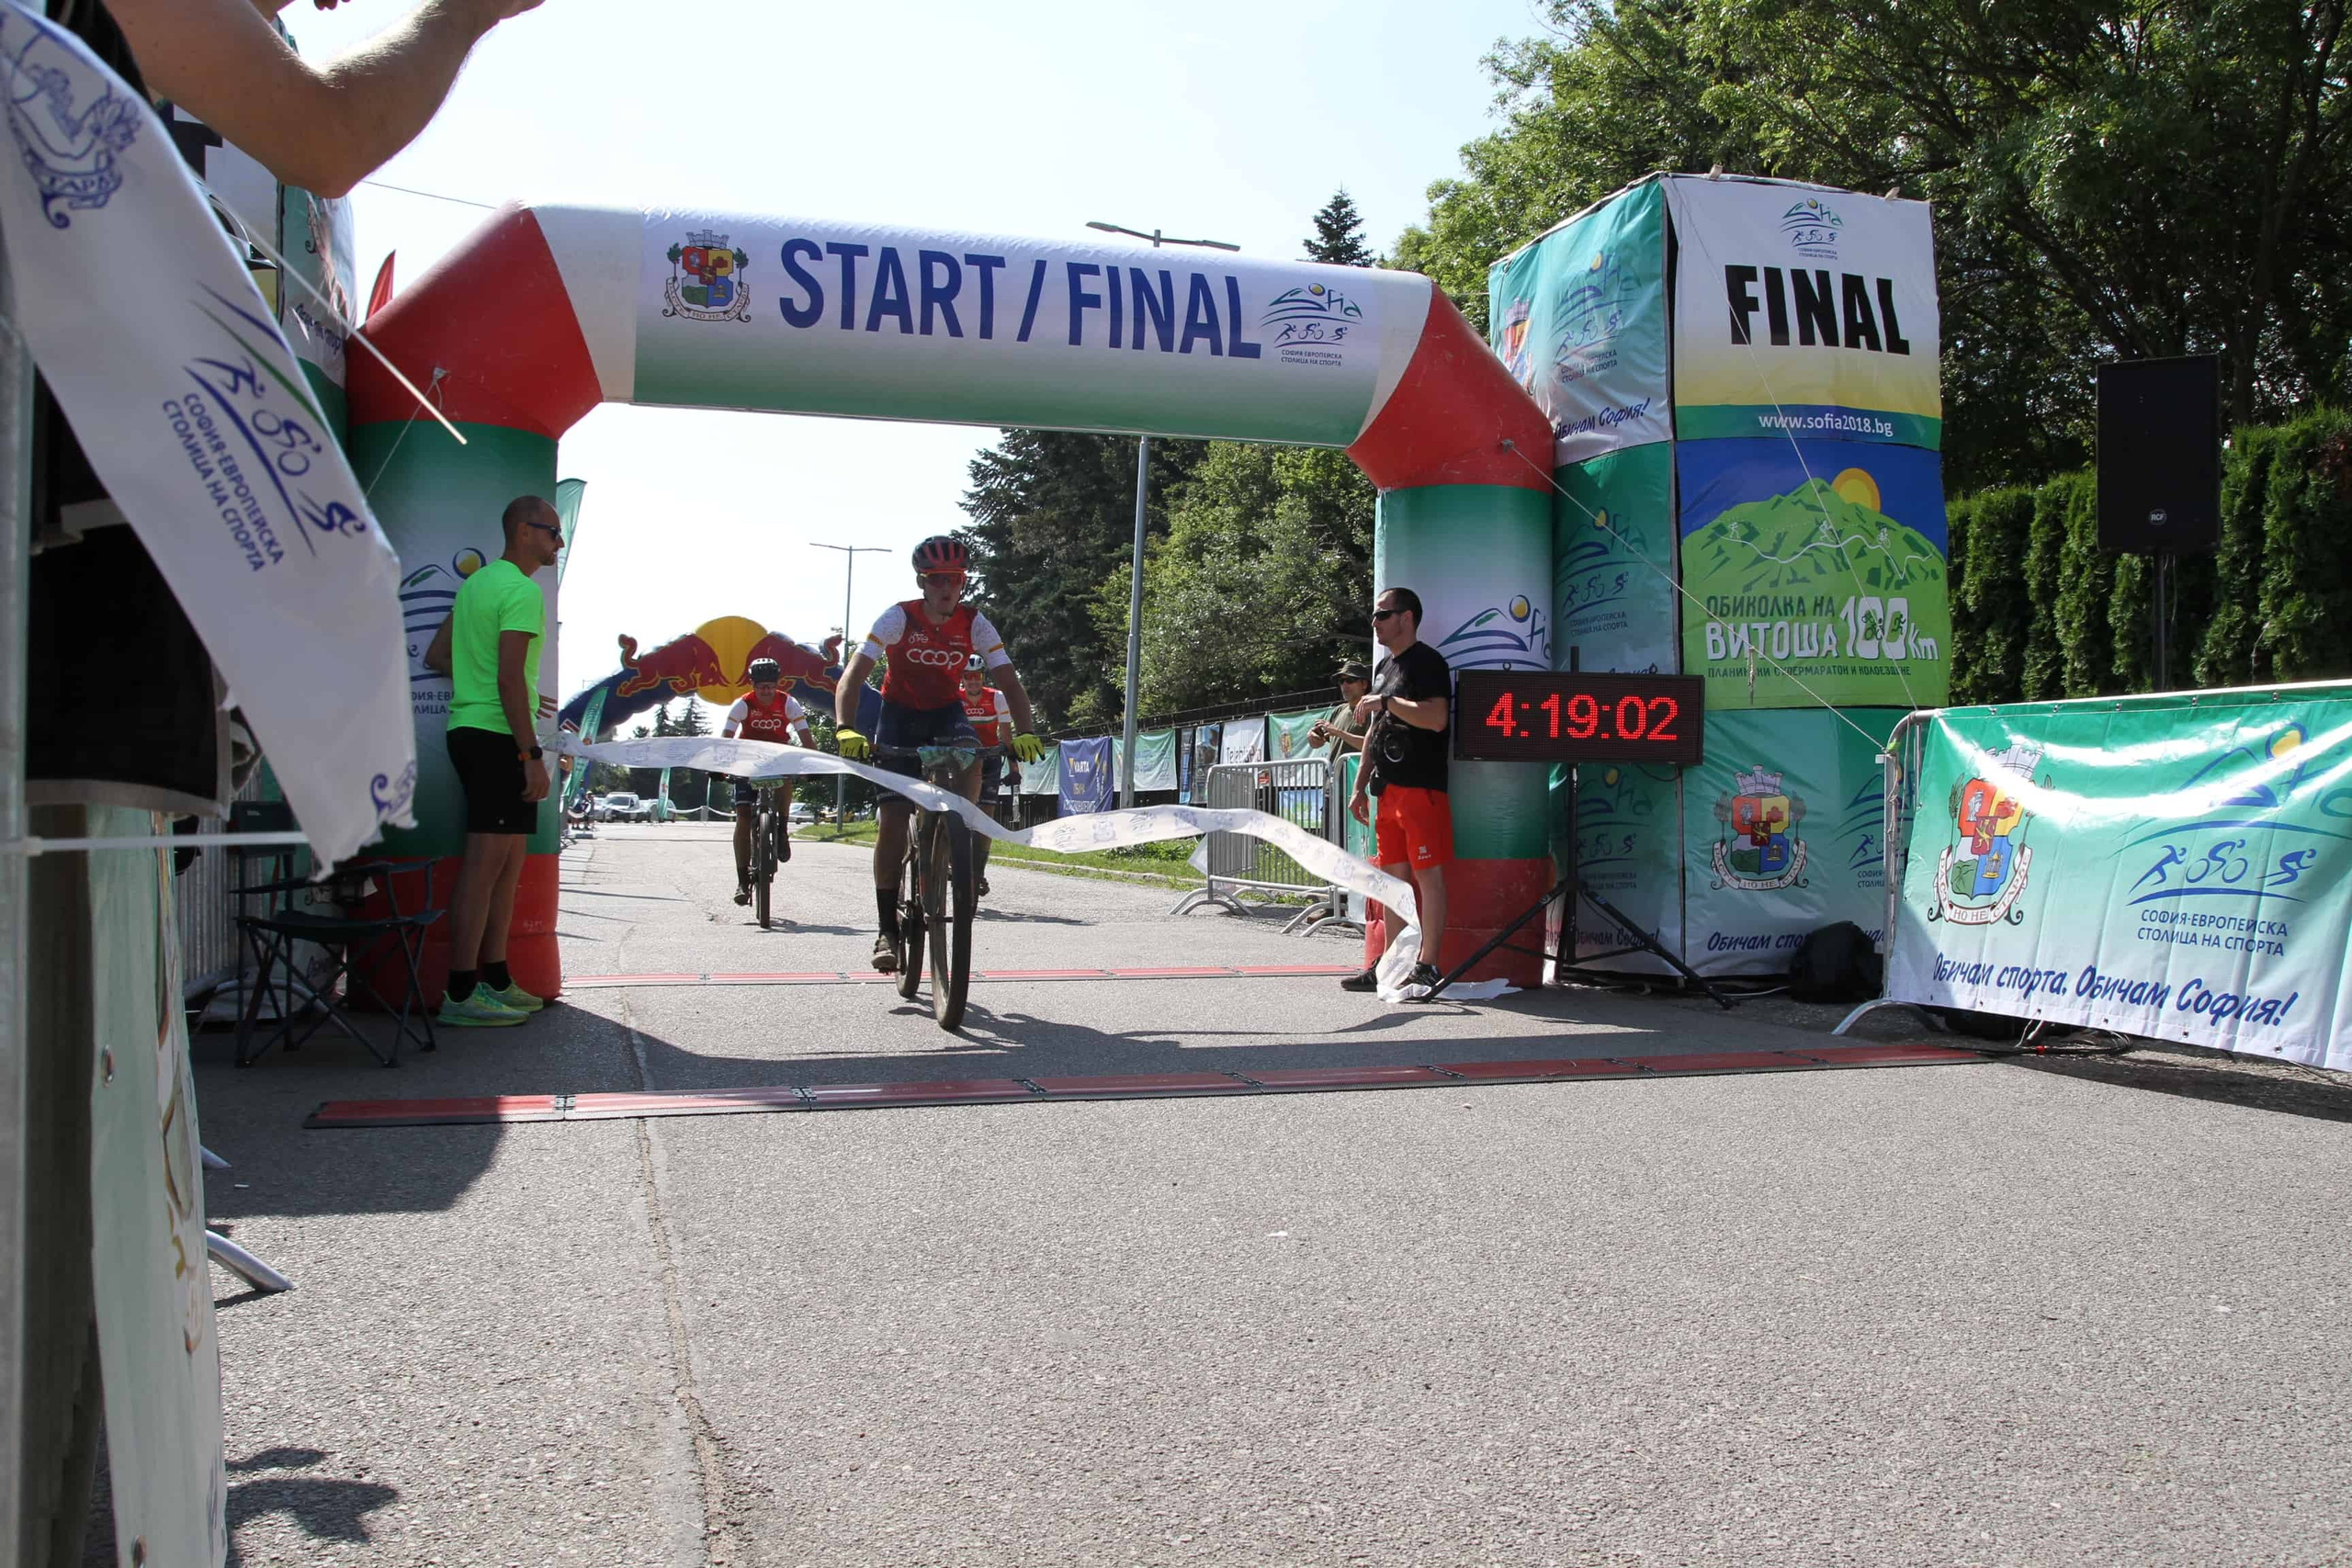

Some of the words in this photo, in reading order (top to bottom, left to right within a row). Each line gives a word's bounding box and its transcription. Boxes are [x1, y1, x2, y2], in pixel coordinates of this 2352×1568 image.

[778, 237, 1006, 342] START
[1068, 264, 1262, 360] FINAL
[1724, 264, 1911, 356] FINAL
[1758, 412, 1894, 438] www.sofia2018.bg
[162, 400, 212, 484] СТОЛИЦА
[206, 477, 232, 507] НА
[222, 505, 266, 573] СПОРТА
[1706, 595, 1806, 618] ОБИКОЛКА
[1813, 597, 1836, 617] НА
[1706, 621, 1839, 660] ВИТОША
[1708, 666, 1771, 678] ПЛАНИКИ
[1486, 693, 1679, 740] 4:19:02
[1858, 880, 1884, 888] СТОЛИЦ
[1953, 908, 1968, 921] НО
[1971, 909, 1987, 921] НЕ
[2141, 908, 2289, 938] СОФИЯ-ЕВРОПЕЙСКА
[1707, 931, 1772, 952] Обичам
[2137, 928, 2199, 947] СТОЛИЦА
[2201, 933, 2222, 948] НА
[2223, 935, 2285, 957] СПОРТА
[1933, 952, 1994, 987] Обичам
[2075, 964, 2171, 1009] Обичам
[2176, 977, 2299, 1030] София!
